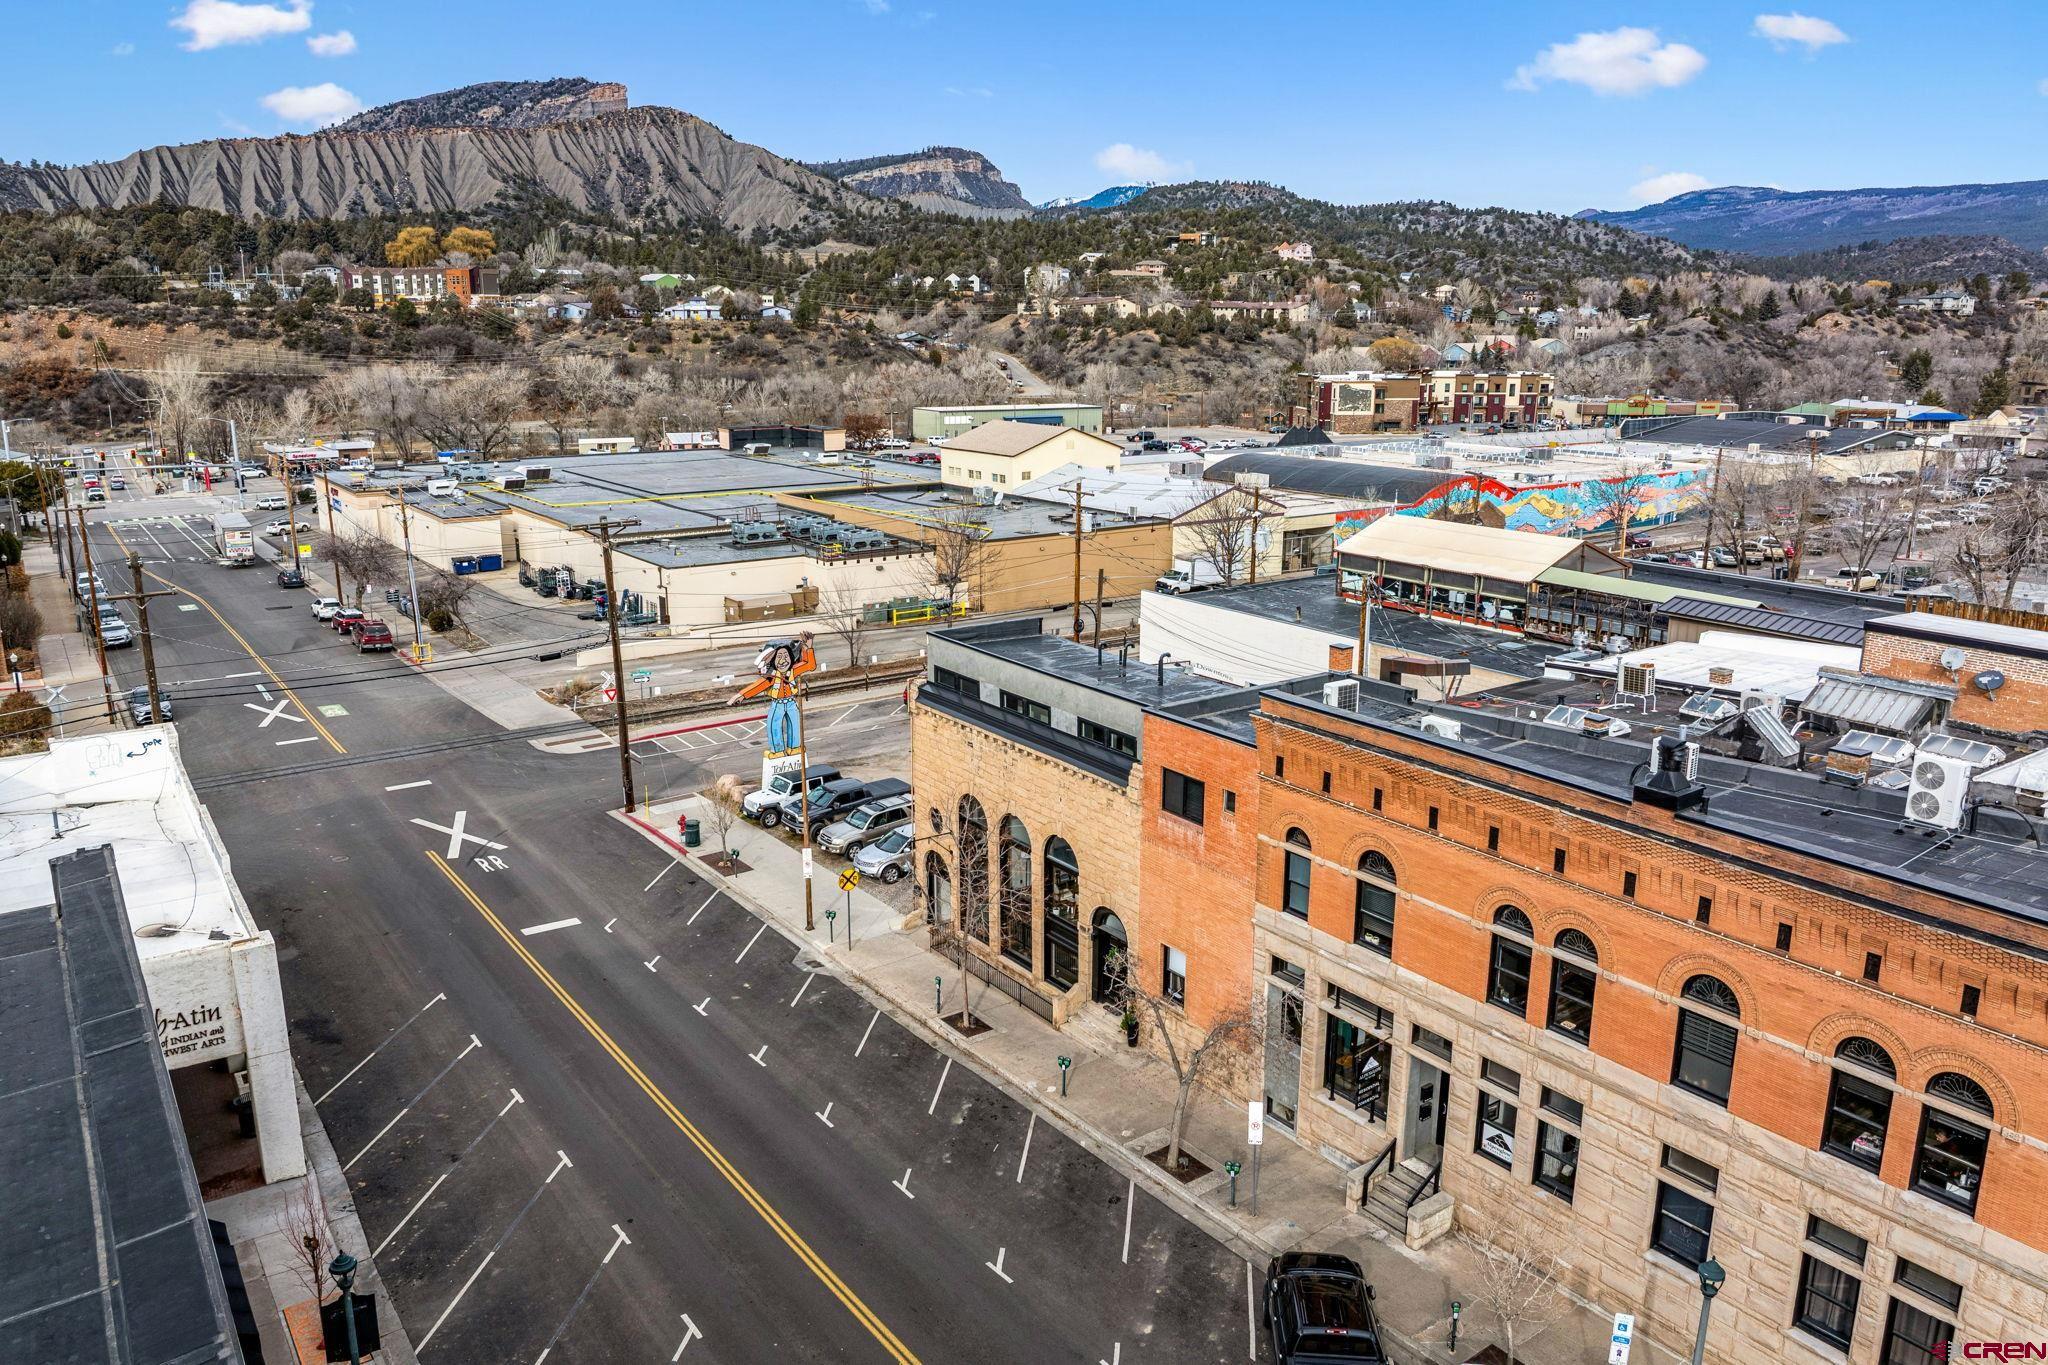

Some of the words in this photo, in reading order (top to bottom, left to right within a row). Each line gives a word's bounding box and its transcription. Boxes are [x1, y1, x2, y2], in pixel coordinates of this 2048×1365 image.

[161, 1036, 168, 1048] of
[170, 1030, 208, 1046] INDIAN
[209, 1025, 225, 1036] and
[201, 1036, 226, 1049] ARTS
